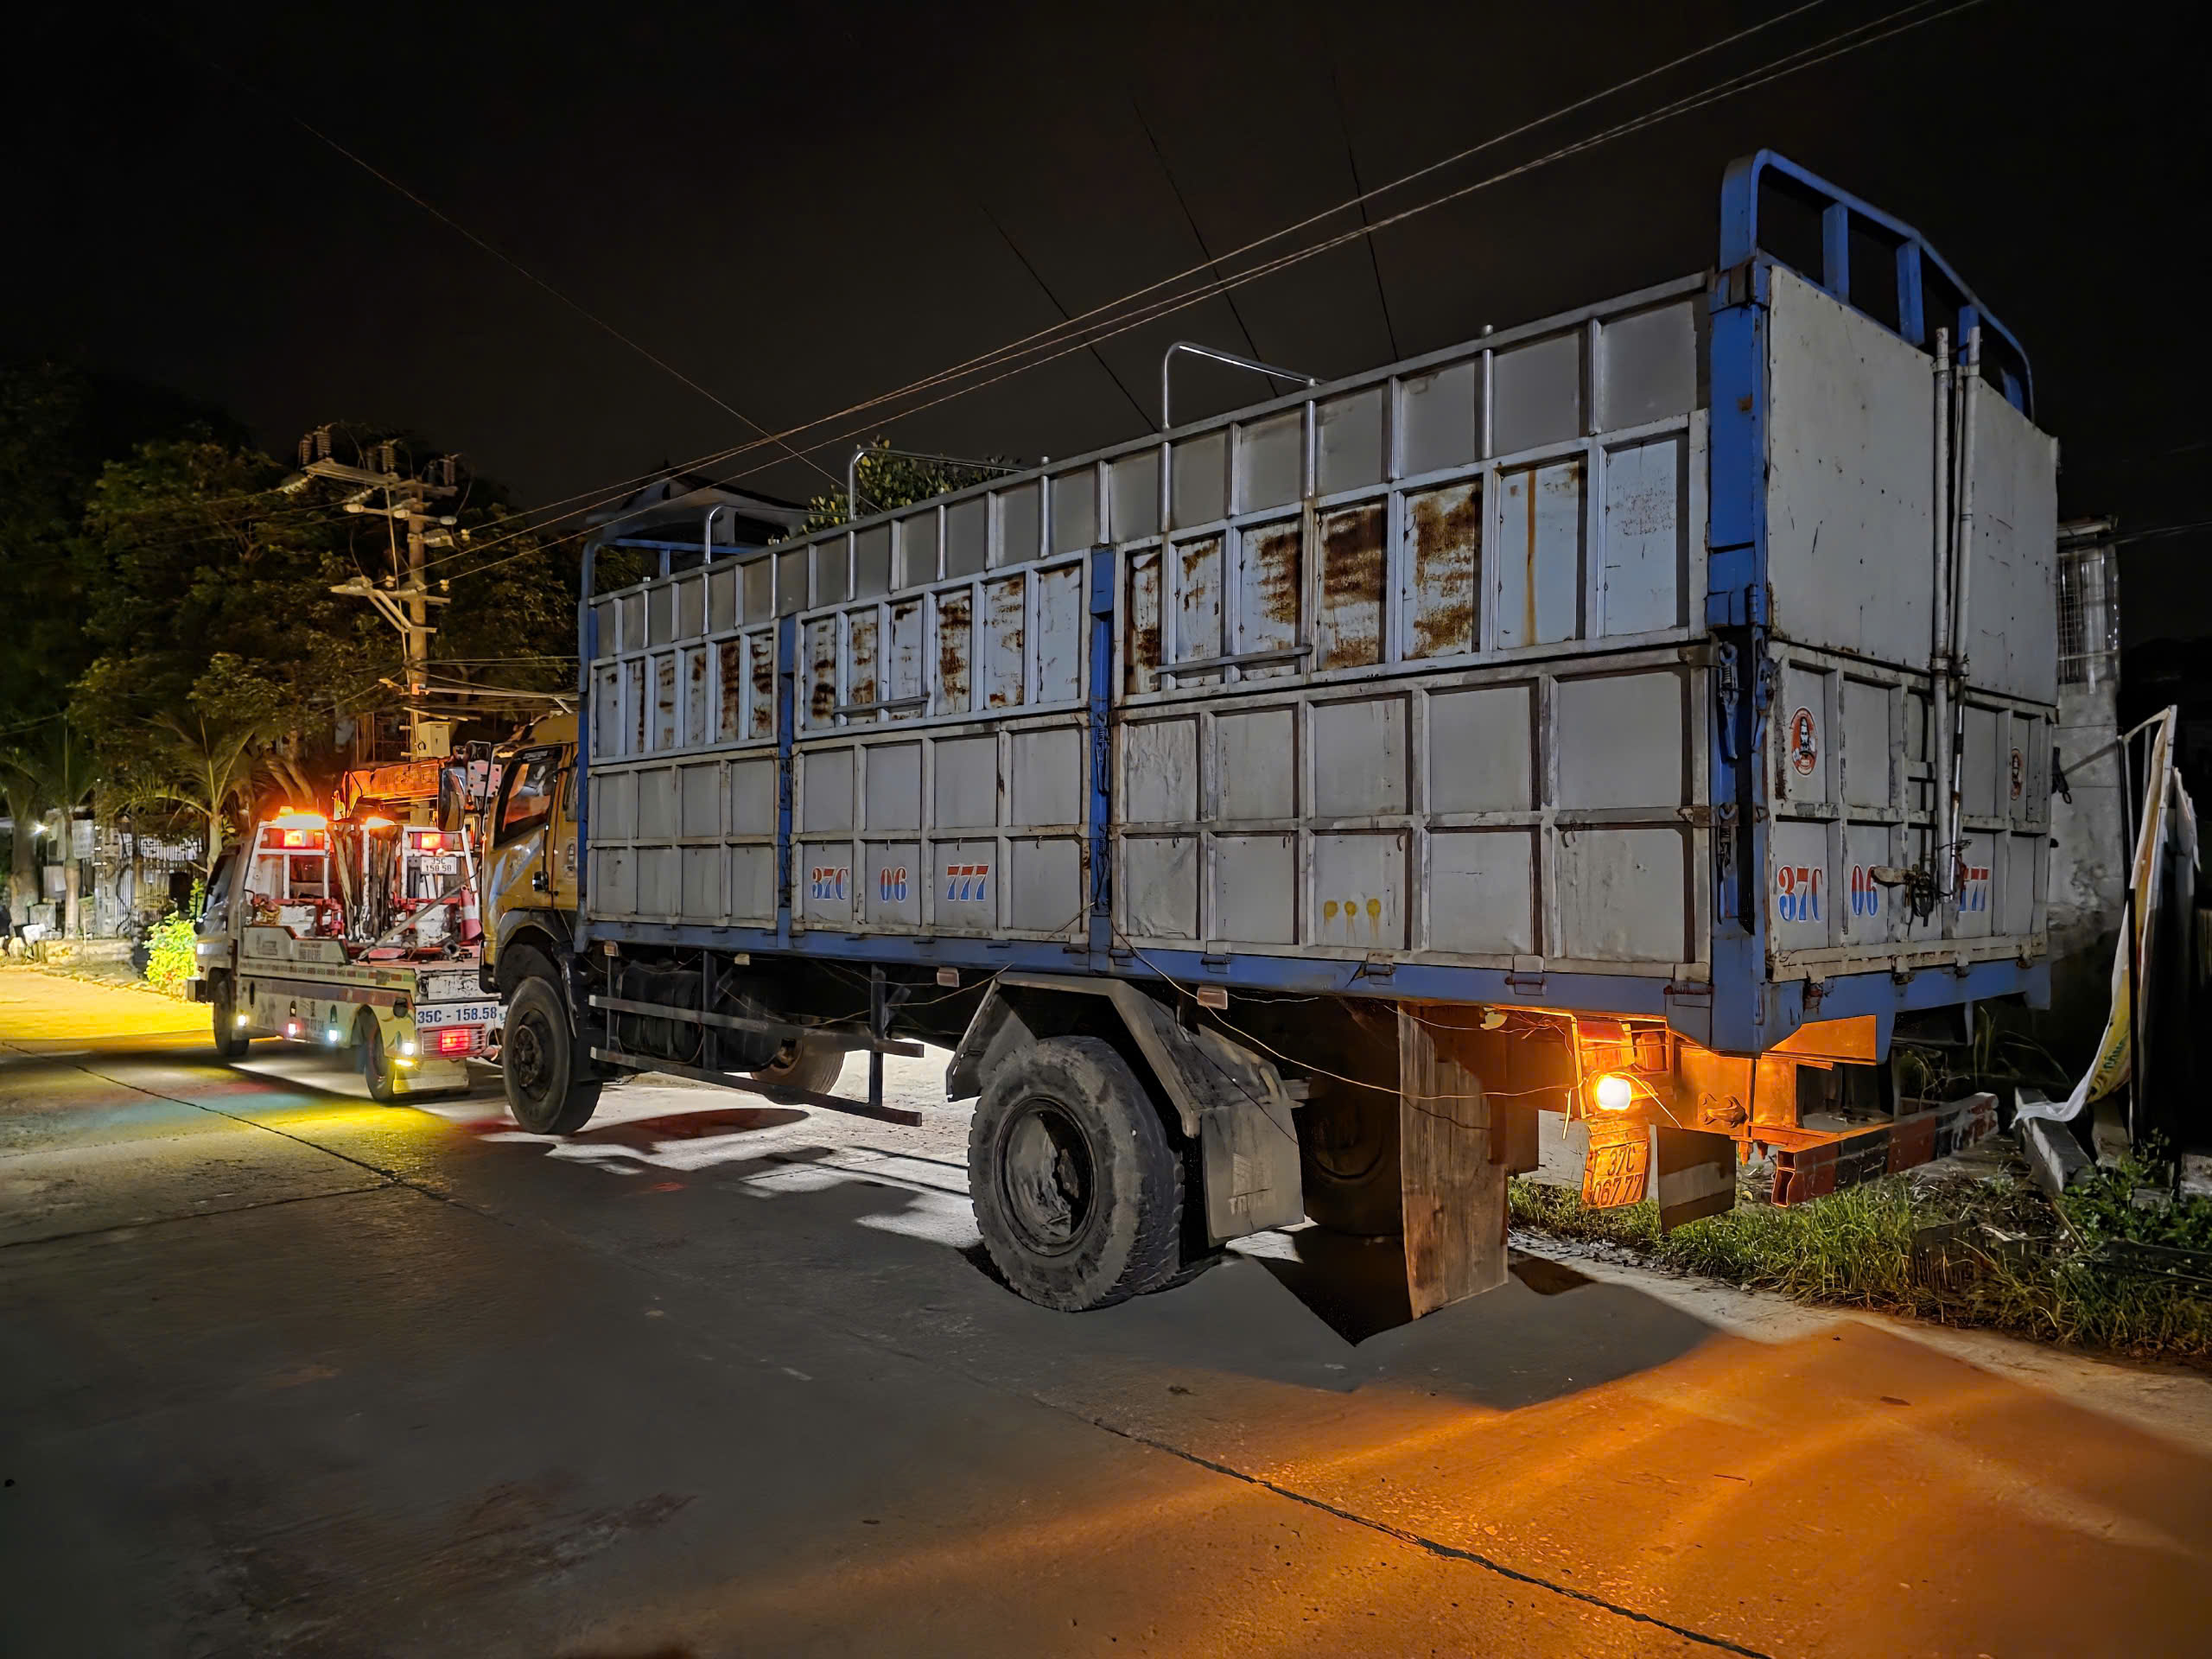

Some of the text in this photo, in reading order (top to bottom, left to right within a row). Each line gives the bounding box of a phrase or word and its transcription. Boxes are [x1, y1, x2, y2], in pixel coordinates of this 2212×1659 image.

[812, 864, 989, 902] 37C 06 777
[1777, 864, 1824, 923] 37C
[1850, 863, 1879, 918] 06
[417, 1009, 442, 1024] 35C
[455, 1006, 498, 1022] 158.58
[1606, 1146, 1637, 1176] 37C
